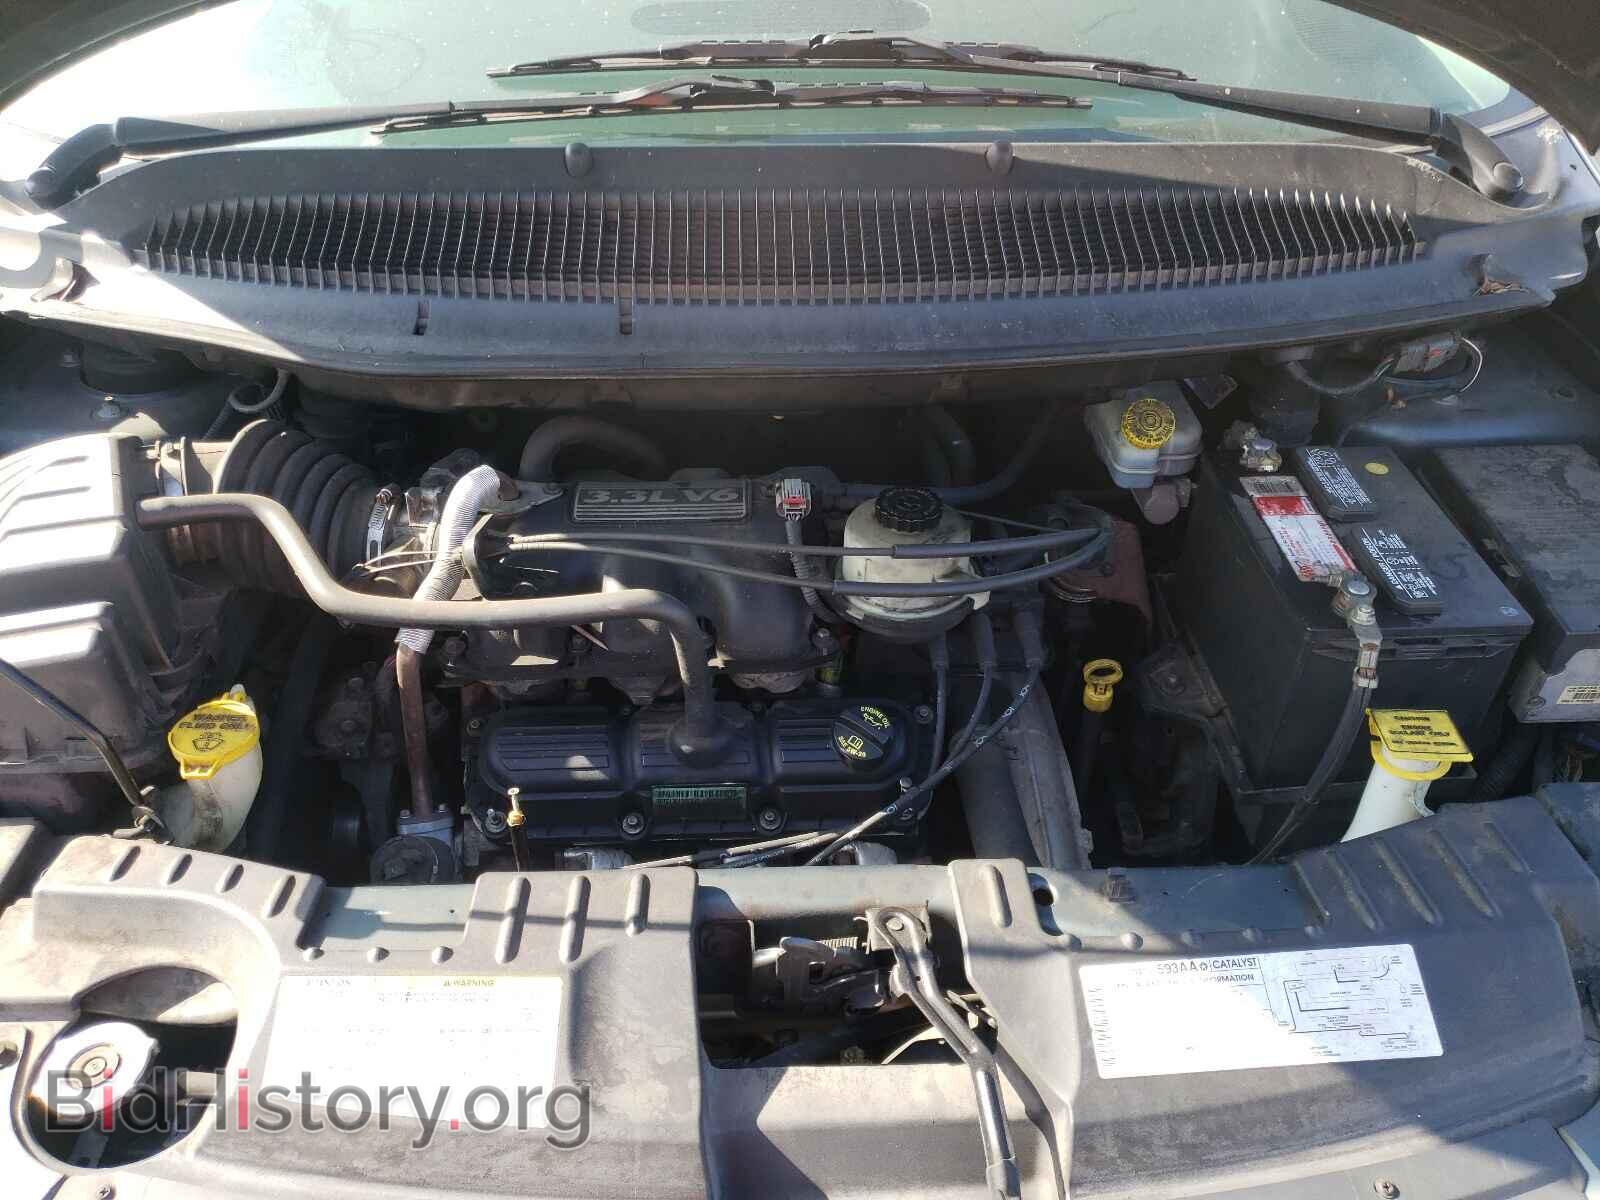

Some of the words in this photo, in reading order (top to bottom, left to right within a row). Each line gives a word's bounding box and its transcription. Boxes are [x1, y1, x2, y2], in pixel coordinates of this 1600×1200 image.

[585, 488, 675, 504] 3.3L
[683, 487, 739, 503] V6
[860, 706, 884, 719] ENGINE
[1212, 957, 1258, 969] CATALYST
[453, 978, 496, 987] WARNING
